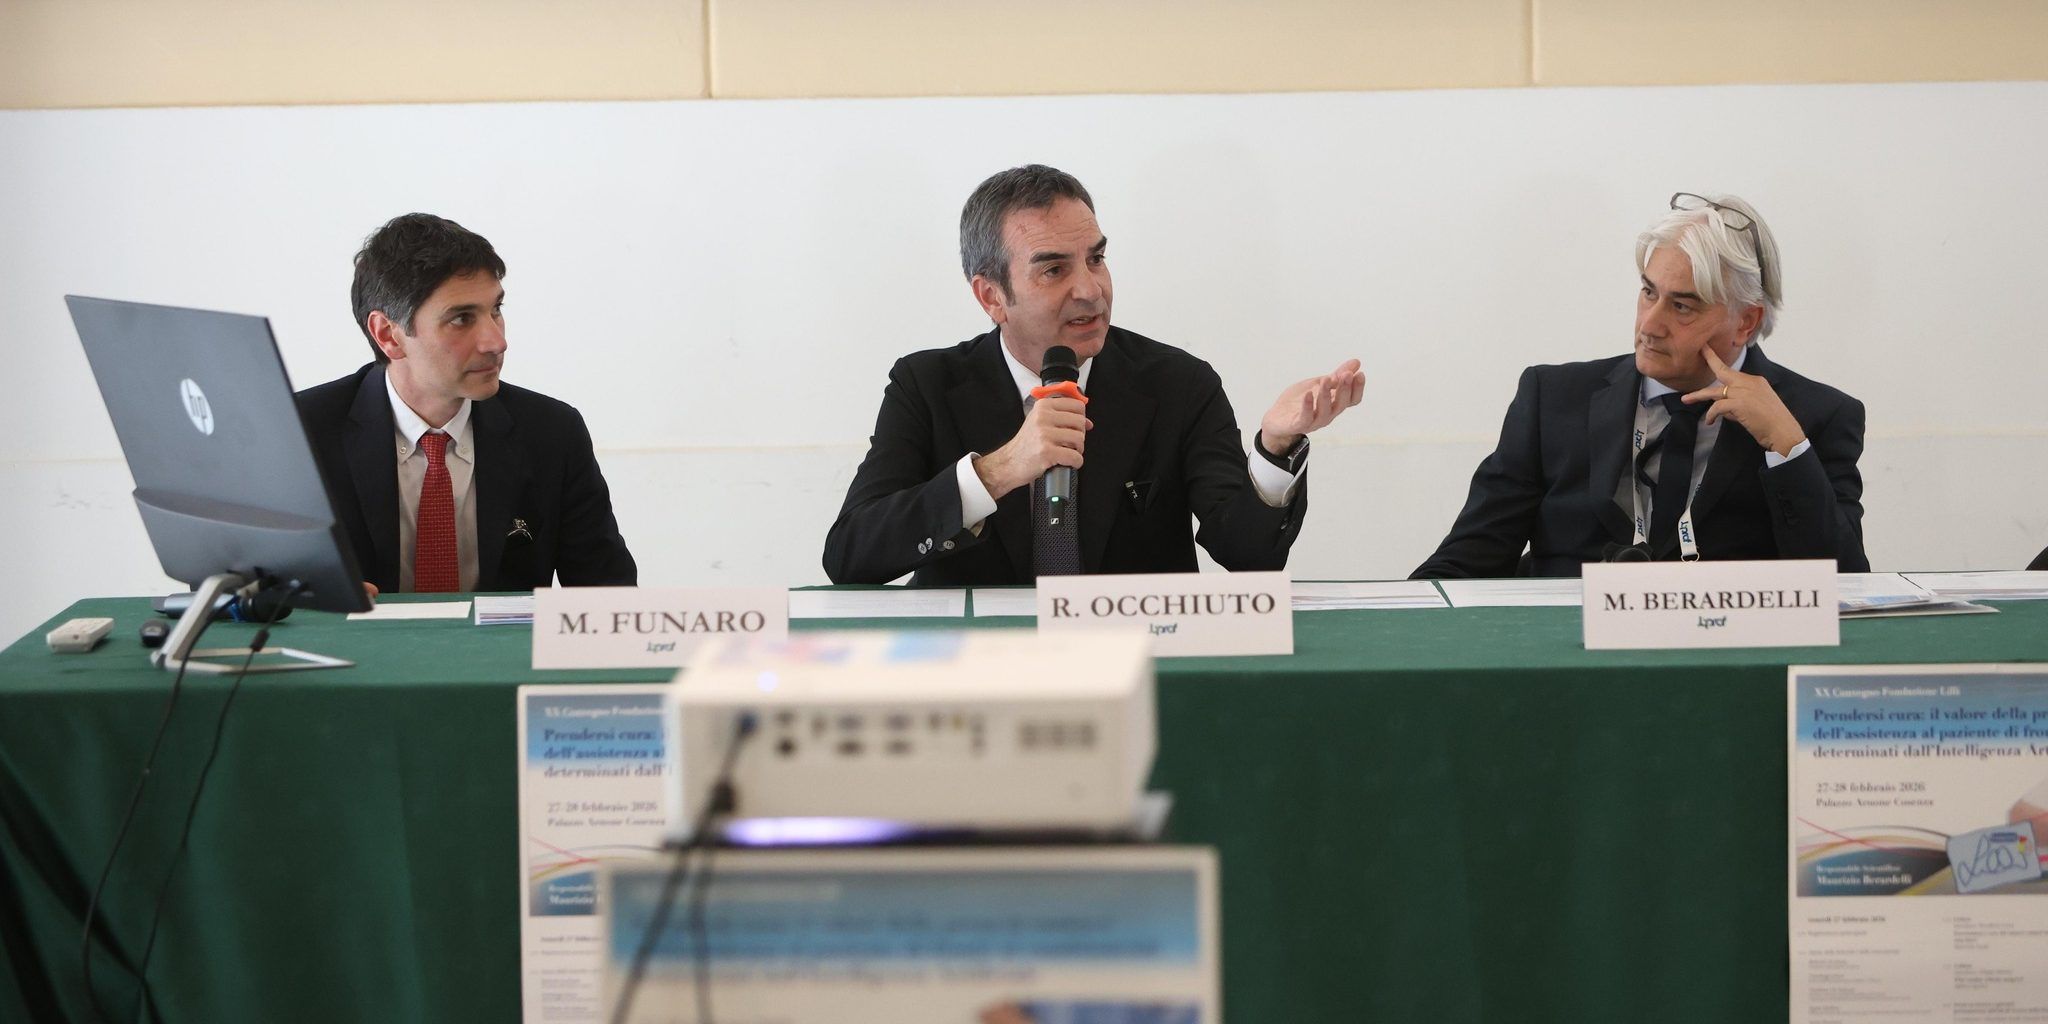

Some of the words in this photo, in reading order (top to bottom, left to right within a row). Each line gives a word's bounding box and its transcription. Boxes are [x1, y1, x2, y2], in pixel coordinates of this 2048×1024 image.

[1051, 597, 1080, 618] R.
[1091, 592, 1276, 618] OCCHIUTO
[1604, 593, 1634, 611] M.
[1643, 590, 1820, 610] BERARDELLI
[559, 613, 598, 634] M.
[610, 610, 766, 634] FUNARO
[1814, 687, 1830, 697] XX
[1813, 708, 1884, 721] Prendersi
[1889, 710, 1924, 720] cura:
[1930, 708, 1939, 719] il
[1944, 709, 1987, 719] valore
[1992, 707, 2027, 719] della
[544, 728, 615, 741] Prendersi
[1813, 727, 1917, 740] dell'assistenza
[1921, 727, 1934, 738] al
[1939, 728, 1999, 742] paziente
[2004, 726, 2018, 738] di
[1813, 745, 1898, 758] determinati
[1903, 744, 2021, 760] dall'Intelligenza
[544, 764, 630, 778] determinati
[1817, 782, 1847, 792] 27-28
[1850, 782, 1896, 792] febbraio
